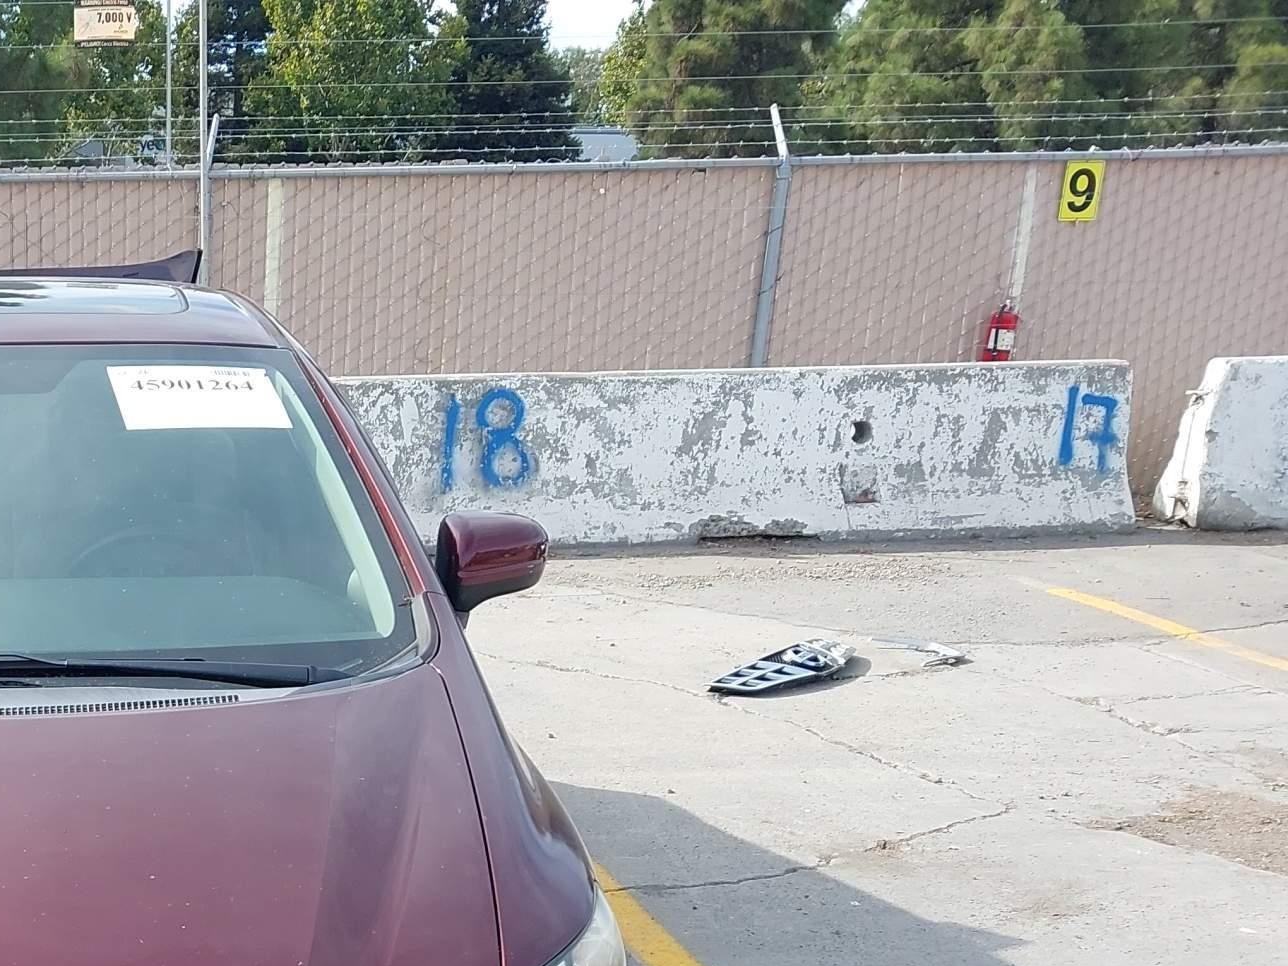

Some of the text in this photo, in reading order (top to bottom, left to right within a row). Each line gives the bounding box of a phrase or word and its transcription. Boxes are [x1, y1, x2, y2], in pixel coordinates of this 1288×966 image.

[97, 12, 132, 24] 7,000 V
[1067, 168, 1096, 212] 9
[131, 379, 254, 391] 45901264
[441, 388, 532, 494] 18
[1059, 385, 1119, 473] 17
